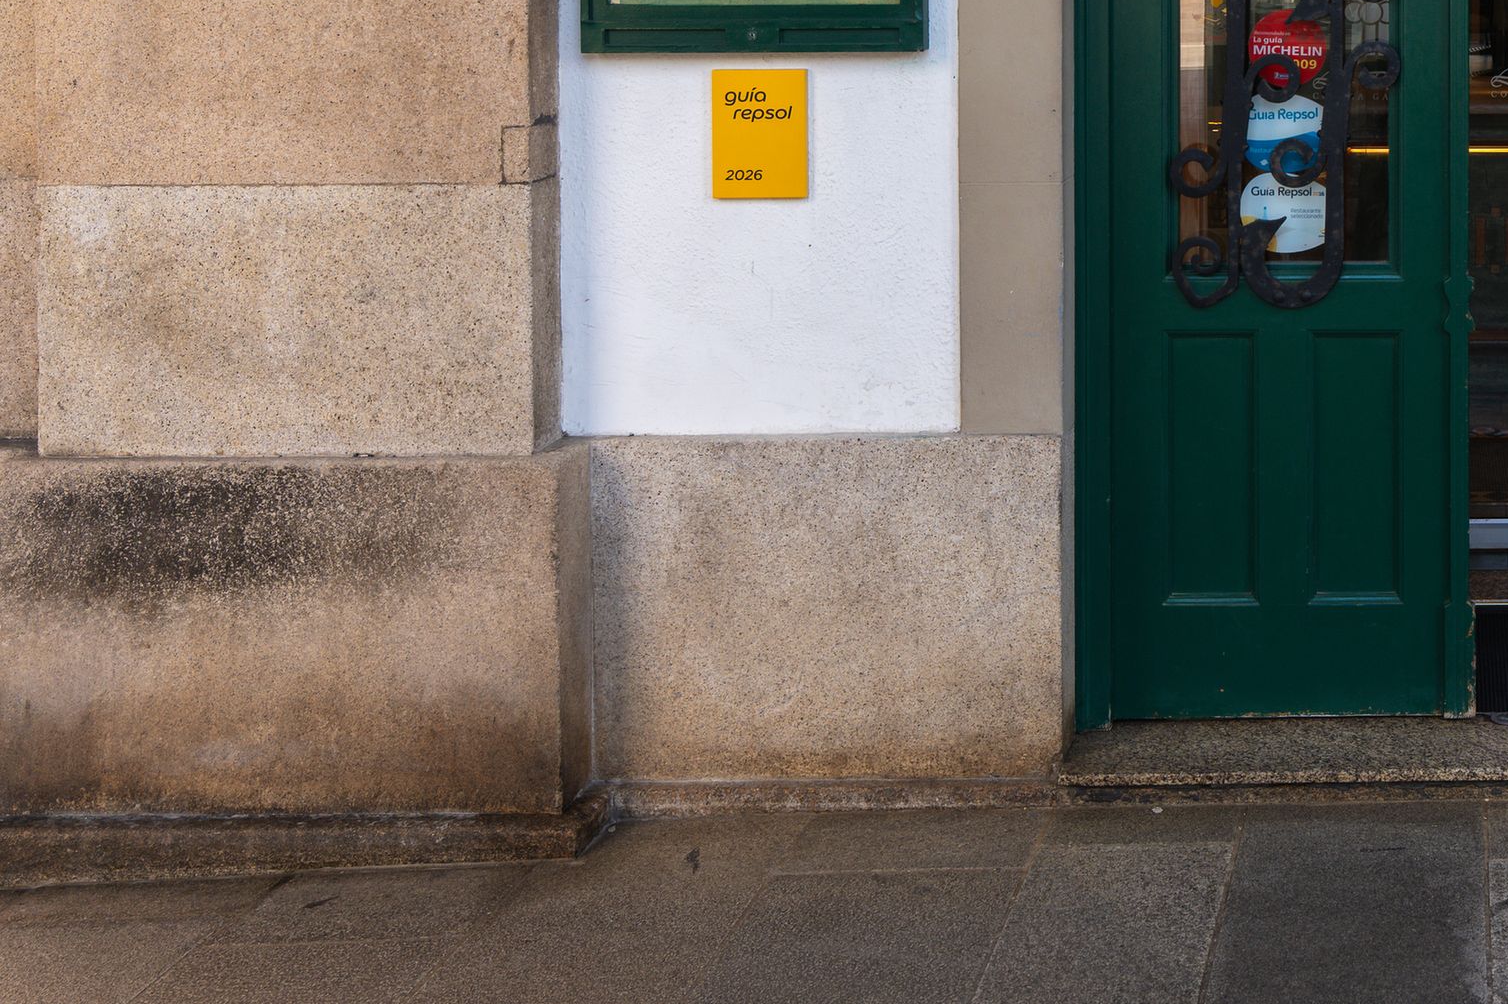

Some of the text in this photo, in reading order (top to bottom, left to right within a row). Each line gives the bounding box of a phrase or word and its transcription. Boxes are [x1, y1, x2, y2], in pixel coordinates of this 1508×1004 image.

[1253, 45, 1323, 57] MICHELIN
[724, 87, 767, 106] guía
[733, 105, 793, 123] repsol
[1277, 107, 1319, 122] Repsol
[725, 169, 763, 181] 2026
[1278, 186, 1312, 199] Repsol
